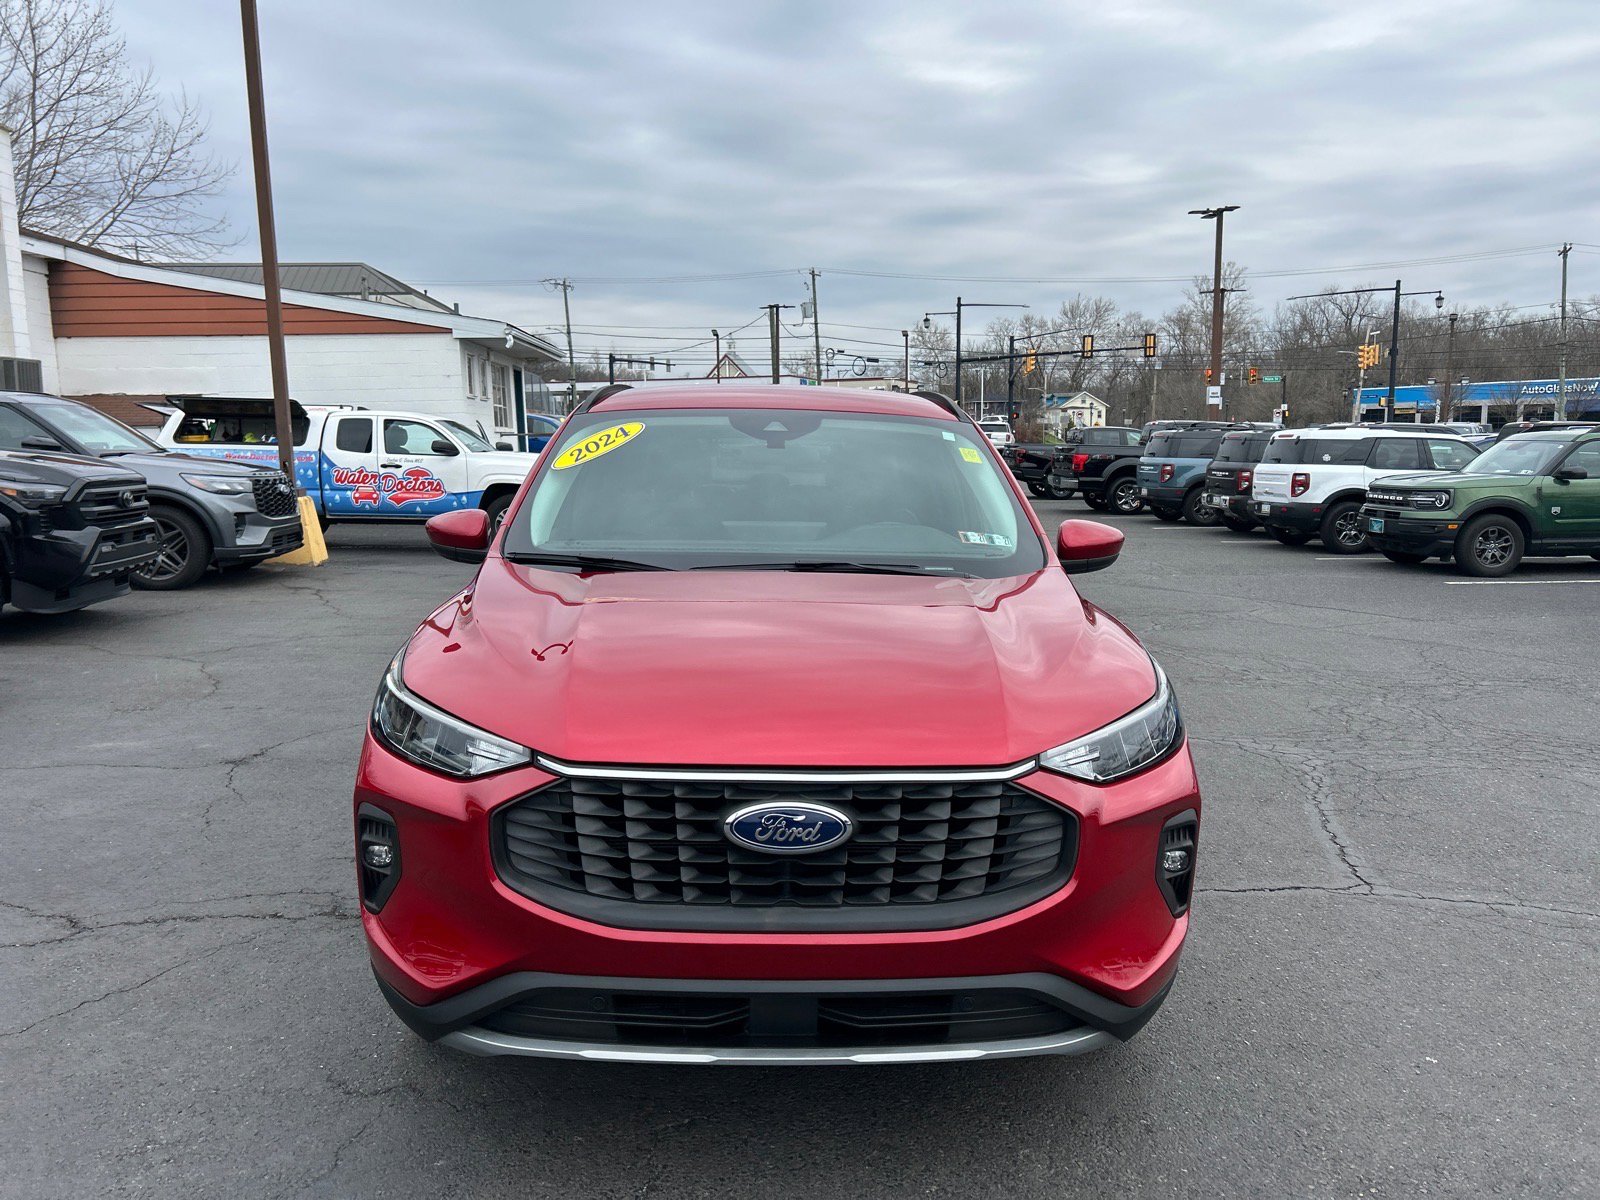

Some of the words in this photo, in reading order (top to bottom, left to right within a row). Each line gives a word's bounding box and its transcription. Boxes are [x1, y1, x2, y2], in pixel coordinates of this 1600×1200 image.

[569, 426, 631, 463] 2024
[332, 467, 380, 486] Water
[381, 473, 445, 493] Doctors
[754, 813, 823, 842] Ford
